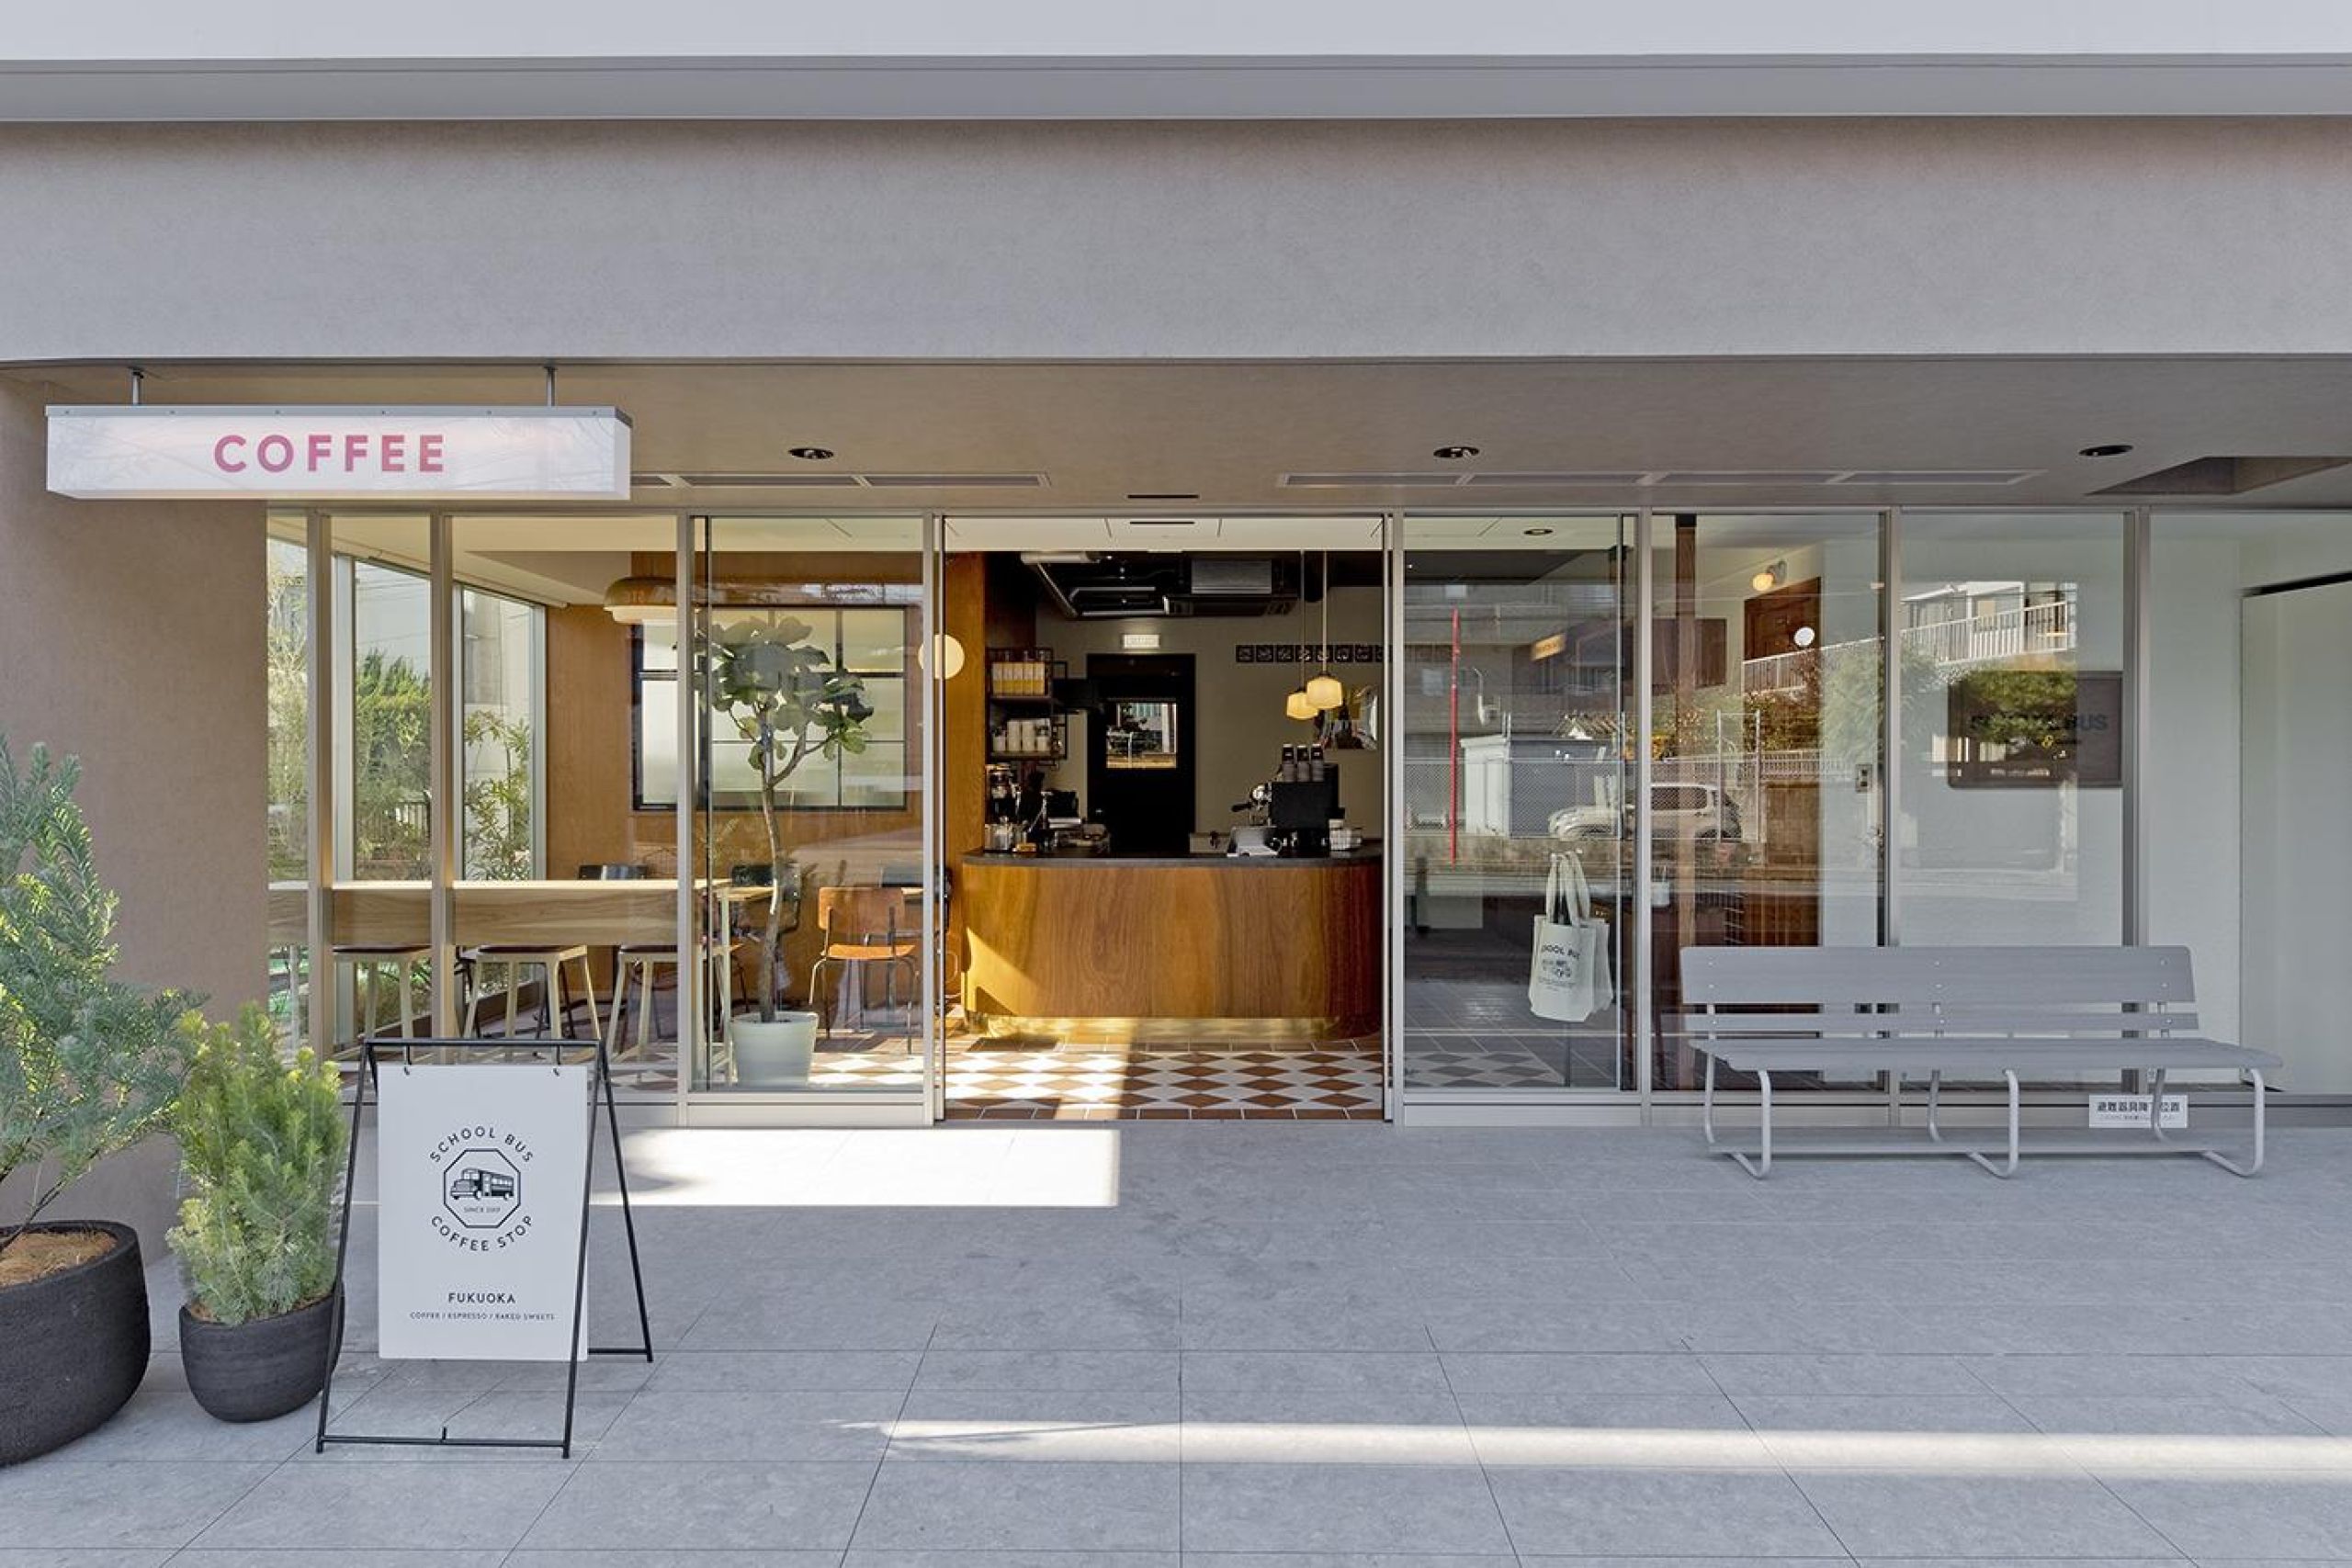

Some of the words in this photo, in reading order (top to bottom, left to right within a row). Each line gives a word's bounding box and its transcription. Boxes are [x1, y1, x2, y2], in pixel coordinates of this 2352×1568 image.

[214, 434, 443, 472] COFFEE
[430, 1126, 495, 1162] SCHOOL
[504, 1134, 533, 1162] BUS
[431, 1216, 489, 1251] COFFEE
[497, 1215, 532, 1247] STOP
[448, 1292, 516, 1304] FUKUOKA
[410, 1312, 439, 1320] COFFEE
[447, 1312, 486, 1320] ESPRESSO
[524, 1313, 555, 1321] SWEETS
